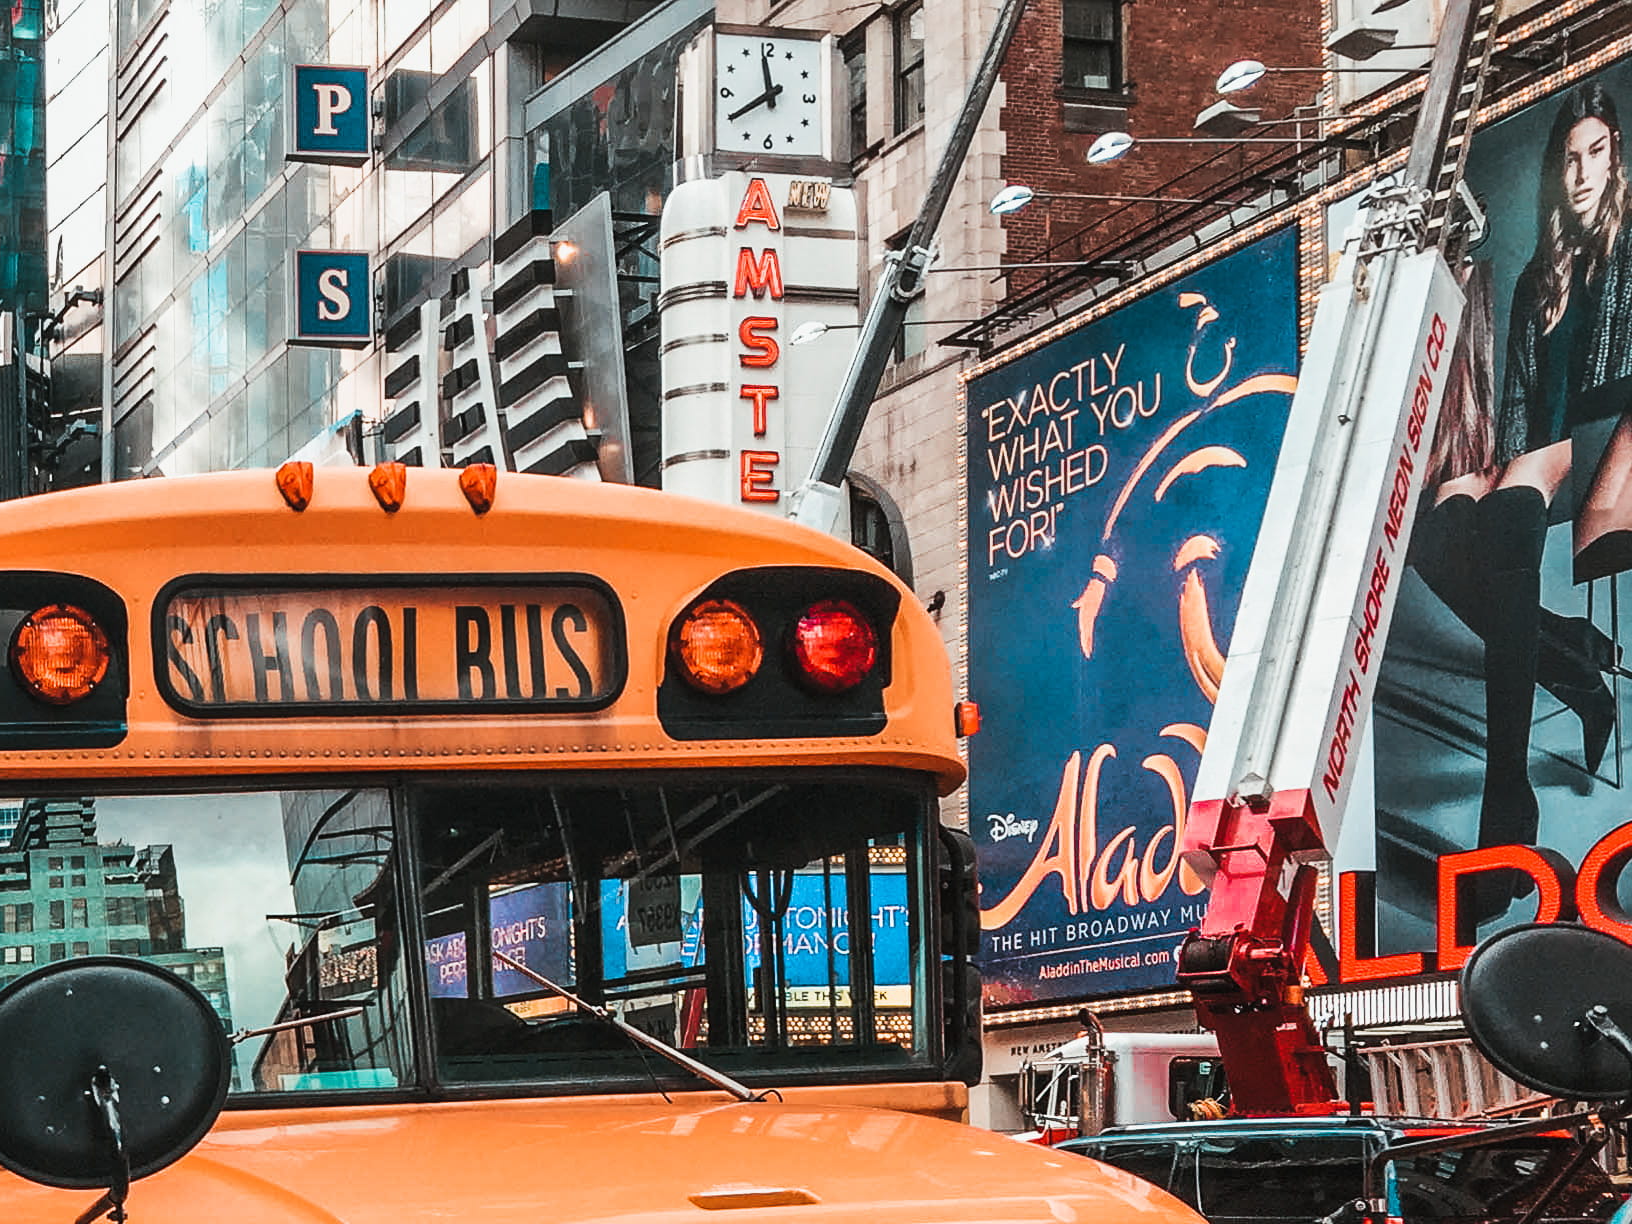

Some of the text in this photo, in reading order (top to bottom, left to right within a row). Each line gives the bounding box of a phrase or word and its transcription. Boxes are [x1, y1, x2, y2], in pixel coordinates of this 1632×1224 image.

[761, 43, 775, 58] 12
[312, 83, 352, 136] P
[763, 134, 773, 149] 6
[789, 180, 832, 210] NEW
[317, 267, 352, 321] S
[988, 372, 1161, 481] WHAT YOU
[987, 444, 1108, 523] WISHED
[1322, 668, 1362, 805] NORTH
[1354, 546, 1390, 675] SHORE
[1383, 443, 1414, 552] NEON
[1407, 362, 1434, 453] SIGN
[168, 603, 596, 703] SCHOOL BUS
[992, 933, 1023, 953] THE
[1030, 927, 1058, 947] HIT
[1066, 908, 1172, 942] BROADWAY
[1038, 949, 1170, 981] AladdinTheMusical.com
